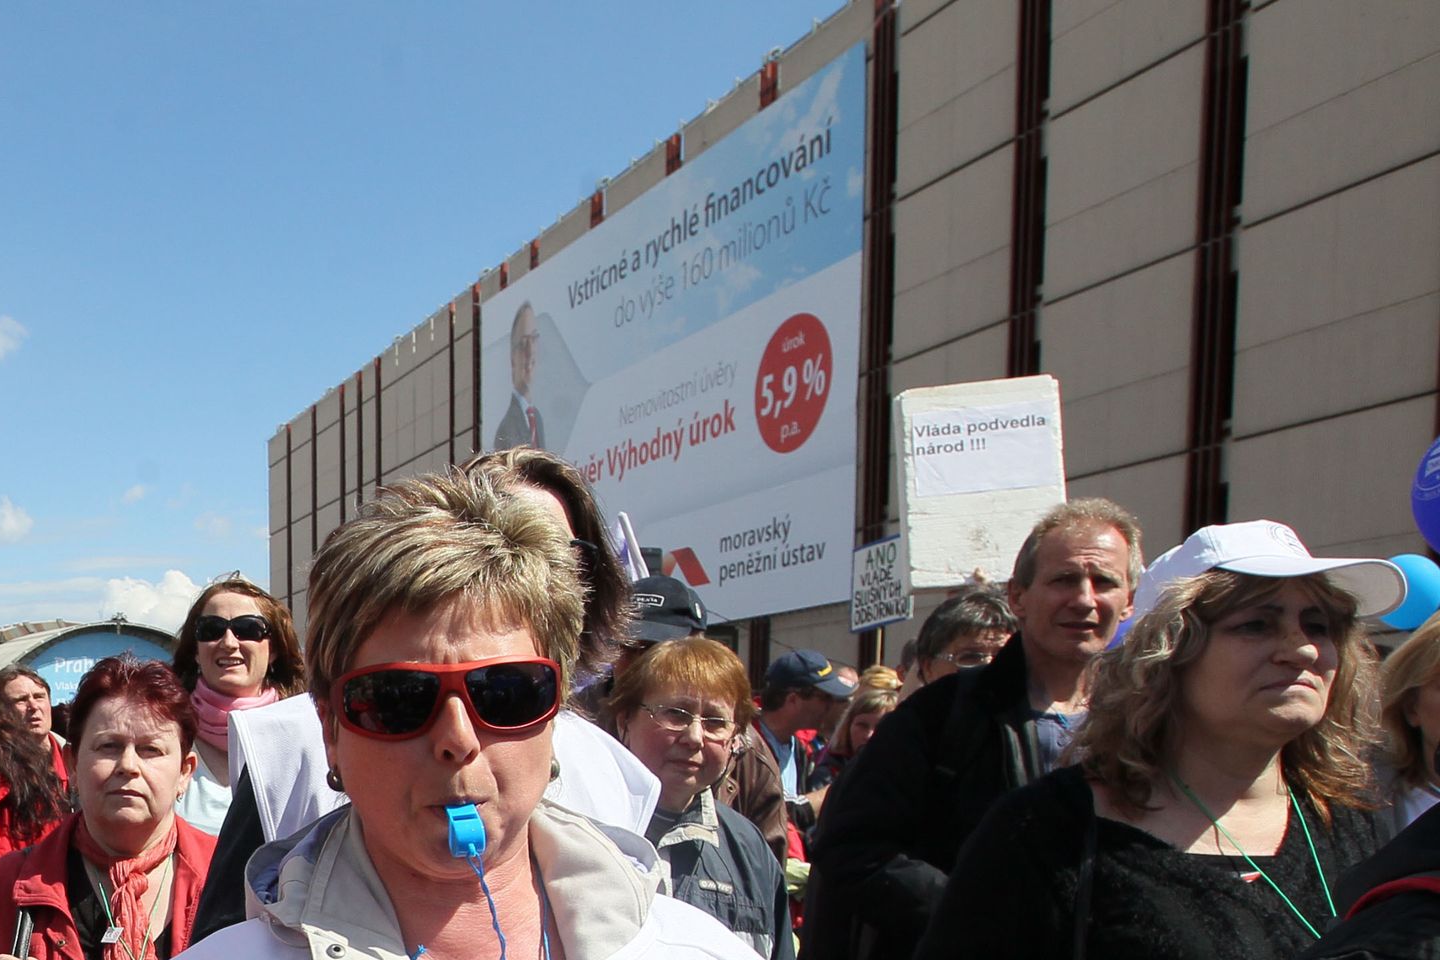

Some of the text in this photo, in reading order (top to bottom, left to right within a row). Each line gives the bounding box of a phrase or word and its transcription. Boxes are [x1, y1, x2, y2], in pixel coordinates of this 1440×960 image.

[568, 116, 833, 309] Vstřícné a rychlé financování
[614, 175, 832, 328] do výše 160 milionů Kč
[782, 329, 806, 353] úrok
[618, 360, 737, 428] Nemovitostní úvěry
[760, 353, 826, 419] 5,9 %
[574, 399, 736, 484] věr Výhodný úrok
[914, 414, 1047, 438] Vláda podvedla
[916, 439, 965, 456] národ
[719, 513, 792, 553] moravský
[865, 542, 897, 570] ANO
[718, 541, 826, 588] peněžní ústav
